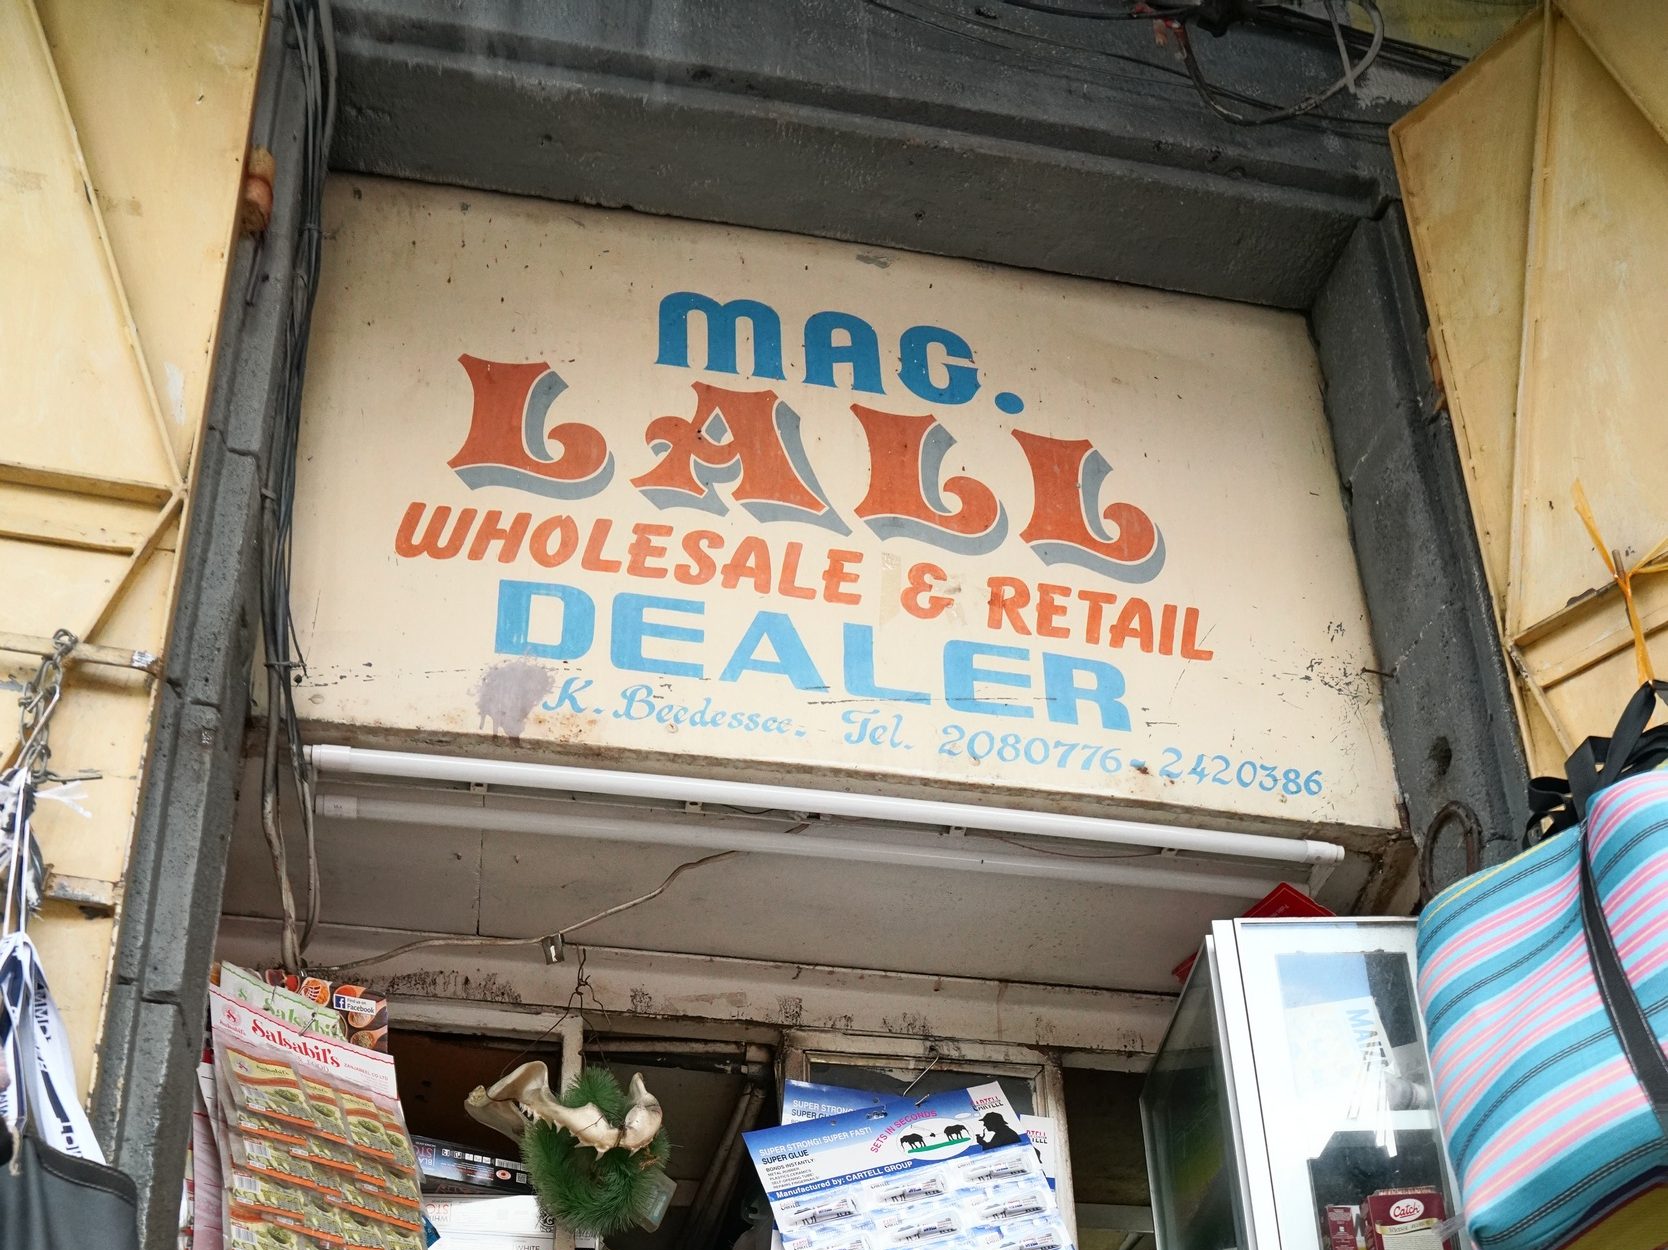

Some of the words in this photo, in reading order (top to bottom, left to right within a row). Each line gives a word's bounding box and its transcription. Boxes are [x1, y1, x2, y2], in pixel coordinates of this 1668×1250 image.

[655, 291, 1025, 415] MAG.
[448, 353, 1166, 584] LALL
[395, 501, 864, 605] WHOLESALE
[900, 562, 954, 620] &
[987, 576, 1214, 661] RETAIL
[494, 578, 1132, 732] DEALER
[542, 676, 606, 715] K.
[841, 708, 913, 751] Tel.
[347, 1003, 375, 1014] Facebook
[251, 1018, 341, 1068] Salsabil's
[792, 1099, 820, 1112] SUPER
[759, 1144, 786, 1158] SUPER
[786, 1136, 822, 1152] STRONG!
[821, 1132, 850, 1145] SUPER
[849, 1126, 873, 1139] FAST!
[870, 1133, 888, 1154] SETS
[886, 1122, 896, 1136] IN
[894, 1109, 938, 1129] SECONDS
[761, 1154, 788, 1166] SUPER
[788, 1149, 810, 1163] GLUE
[775, 1181, 831, 1200] Manufactured
[832, 1176, 846, 1188] by:
[846, 1168, 885, 1184] CARTELL
[885, 1160, 914, 1174] GROUP
[1393, 1202, 1420, 1218] Catch
